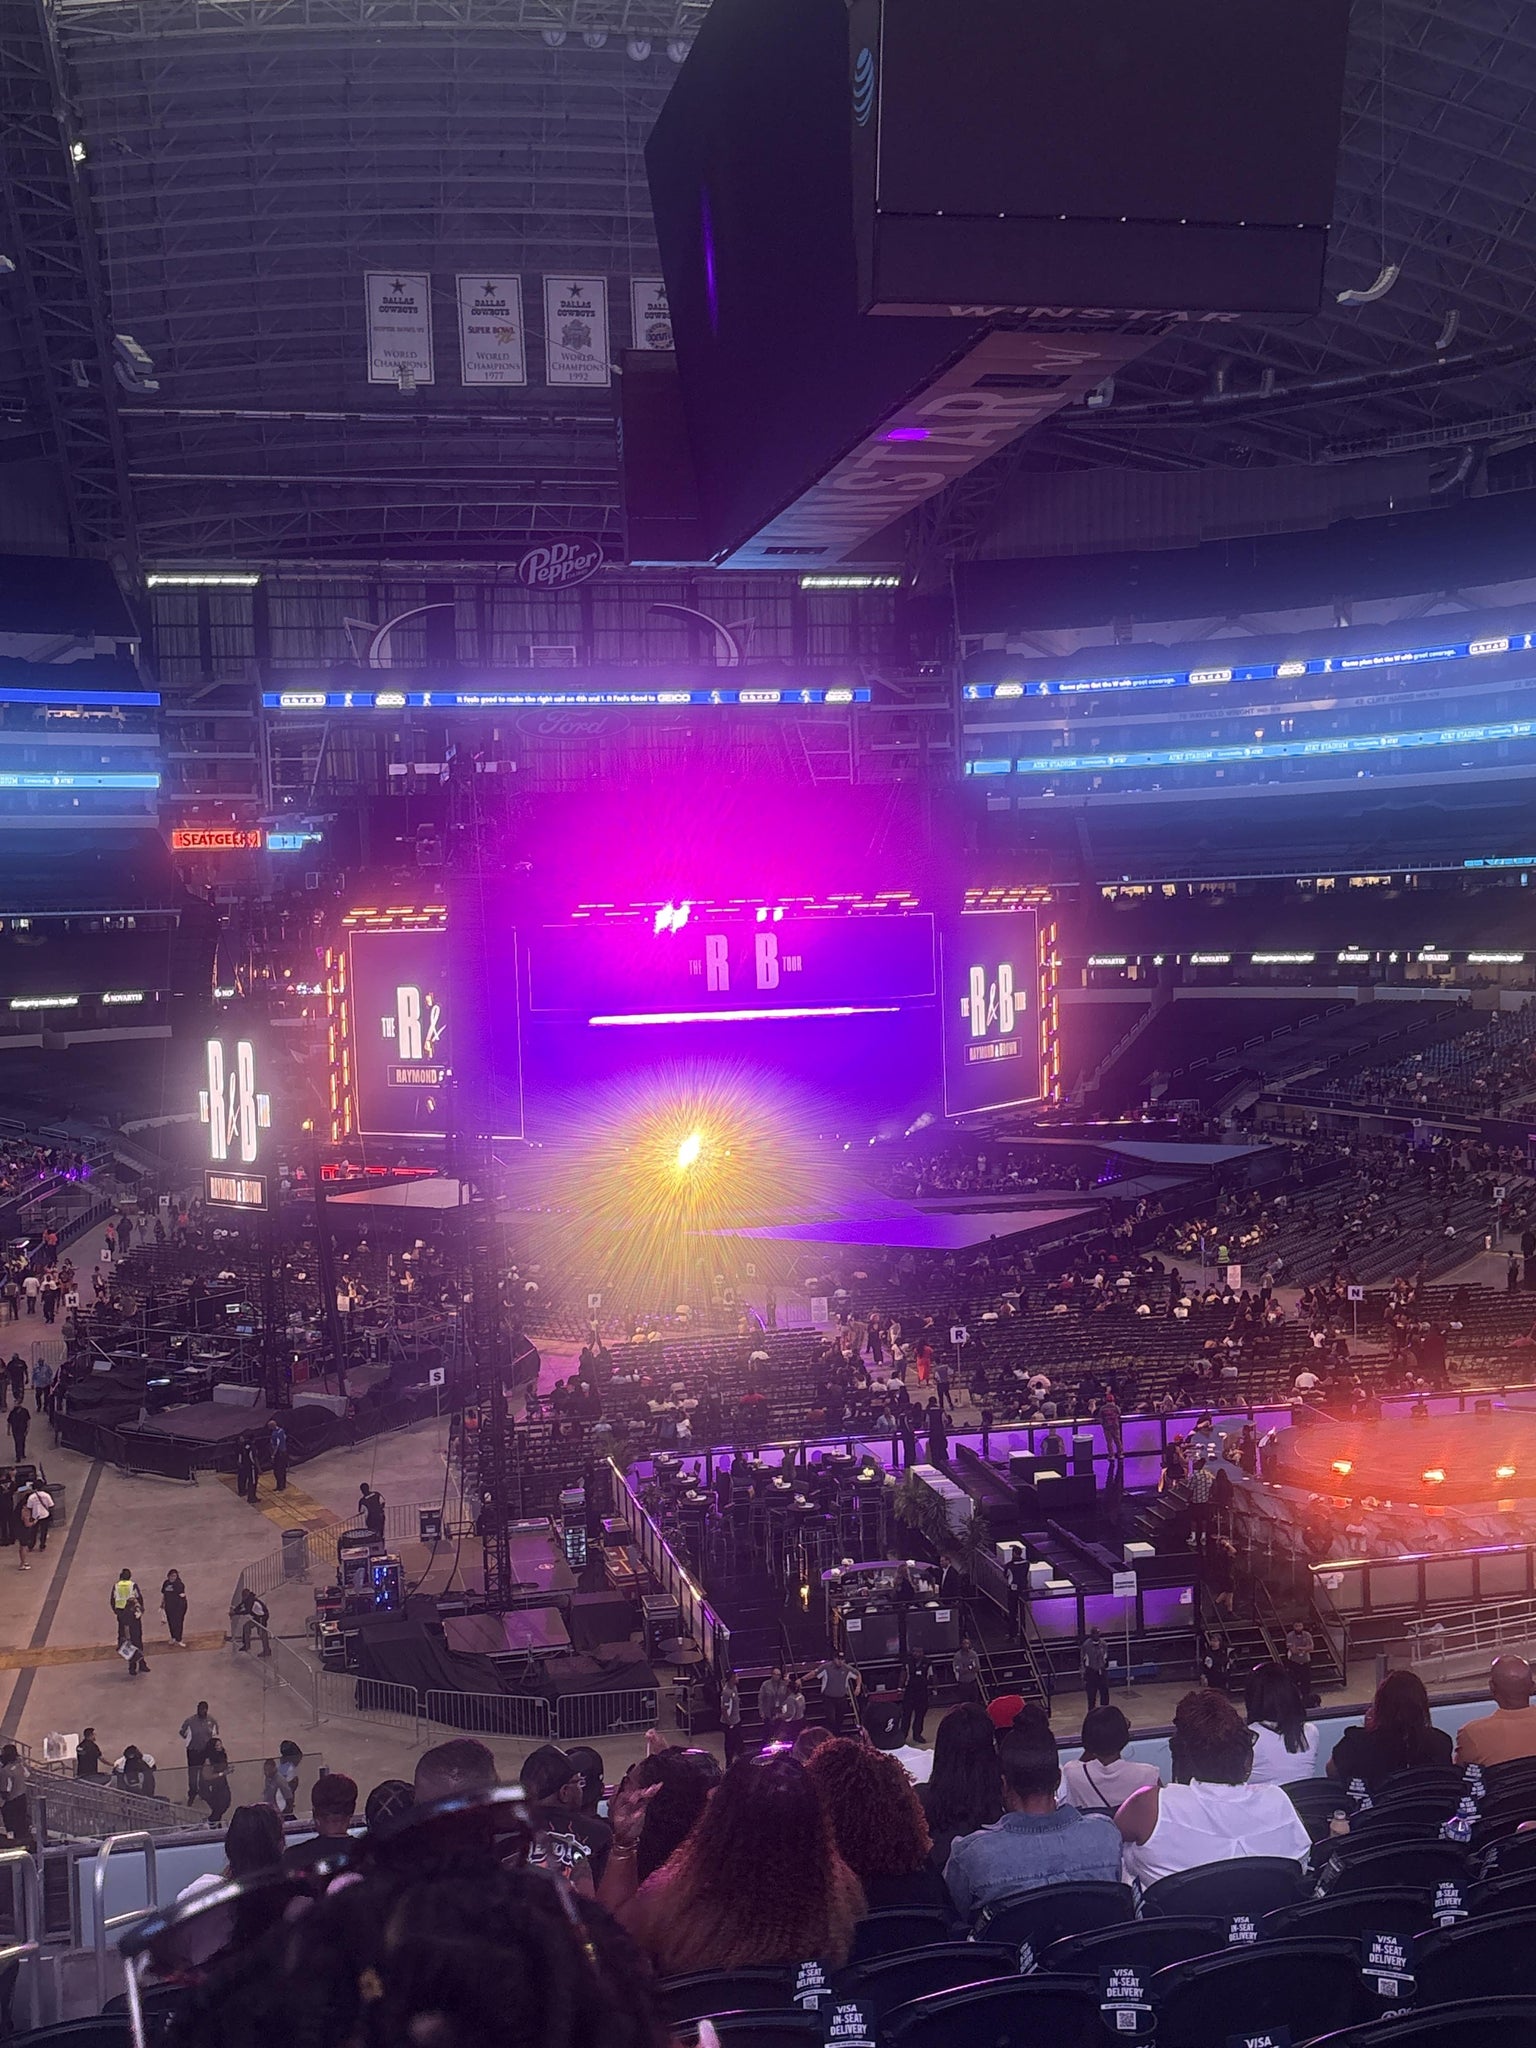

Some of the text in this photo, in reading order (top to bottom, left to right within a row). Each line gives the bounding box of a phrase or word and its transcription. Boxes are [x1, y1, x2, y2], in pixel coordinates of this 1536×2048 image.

[382, 297, 414, 305] DALLAS
[378, 306, 418, 314] COWBOYS
[471, 308, 510, 316] COWBOYS
[947, 305, 1242, 323] WINSTAR
[467, 326, 490, 334] SUPER
[384, 350, 417, 358] WORLD
[476, 352, 509, 360] WORLD
[561, 352, 594, 361] WORLD
[374, 359, 428, 369] CHAMPIONS
[467, 361, 521, 370] CHAMPIONS
[551, 362, 605, 371] CHAMPIONS
[484, 372, 504, 380] 1977
[568, 372, 589, 381] 1992
[770, 391, 1067, 544] WINSTAR
[550, 543, 580, 565] Dr
[524, 548, 597, 585] Pepper
[657, 693, 691, 703] GEICO
[539, 710, 609, 734] Ford
[782, 955, 802, 972] TOUR
[970, 964, 1014, 1037] R&B
[381, 1017, 395, 1037] THE
[396, 1069, 437, 1084] RAYMOND
[207, 1040, 257, 1162] R&B
[1351, 1289, 1360, 1297] N
[68, 1296, 76, 1304] H
[955, 1330, 963, 1340] R
[433, 1371, 441, 1381] S
[1438, 1882, 1454, 1890] VISA
[1436, 1889, 1459, 1898] IN-SEAT
[1434, 1897, 1462, 1907] DELIVERY
[1230, 1923, 1255, 1932] IN-SEAT
[1228, 1932, 1257, 1942] DELIVERY
[1376, 1935, 1397, 1945] VISA
[1372, 1943, 1403, 1956] IN-SEAT
[801, 1961, 818, 1969] VISA
[1369, 1953, 1407, 1967] DELIVERY
[798, 1968, 823, 1979] IN-SEAT
[1112, 1968, 1134, 1977] VISA
[796, 1976, 825, 1989] DELIVERY
[1109, 1977, 1140, 1987] IN-SEAT
[1106, 1988, 1144, 1998] DELIVERY
[836, 2004, 857, 2013] VISA
[833, 2013, 863, 2025] IN-SEAT
[830, 2024, 867, 2036] DELIVERY
[1243, 2036, 1272, 2048] VISA
